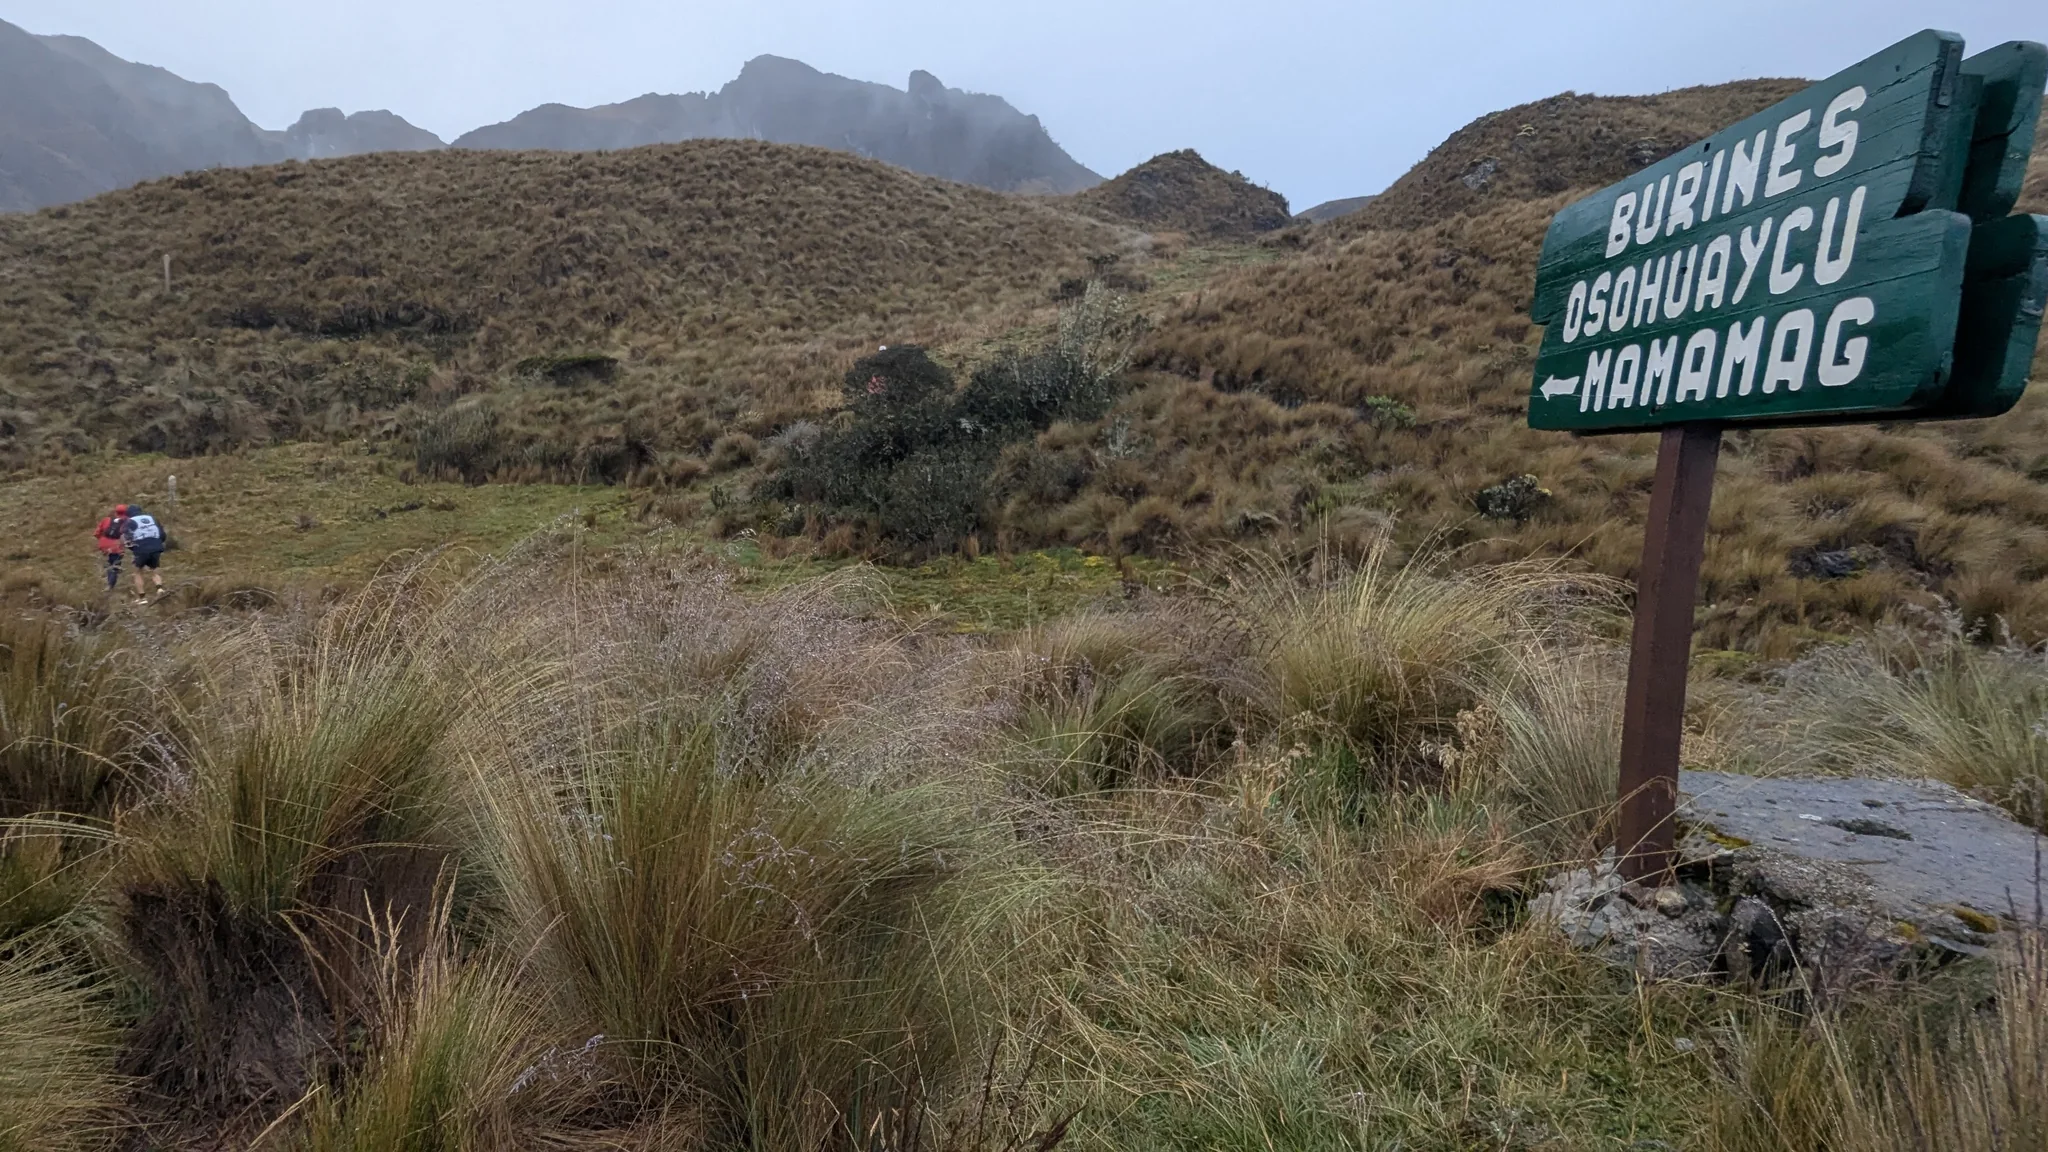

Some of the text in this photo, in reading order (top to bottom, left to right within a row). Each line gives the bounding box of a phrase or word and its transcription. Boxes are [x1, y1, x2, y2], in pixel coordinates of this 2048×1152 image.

[1606, 86, 1867, 258] BURINES
[1563, 186, 1867, 343] OSOHUAYCU
[1580, 297, 1875, 413] MAMAMAG
